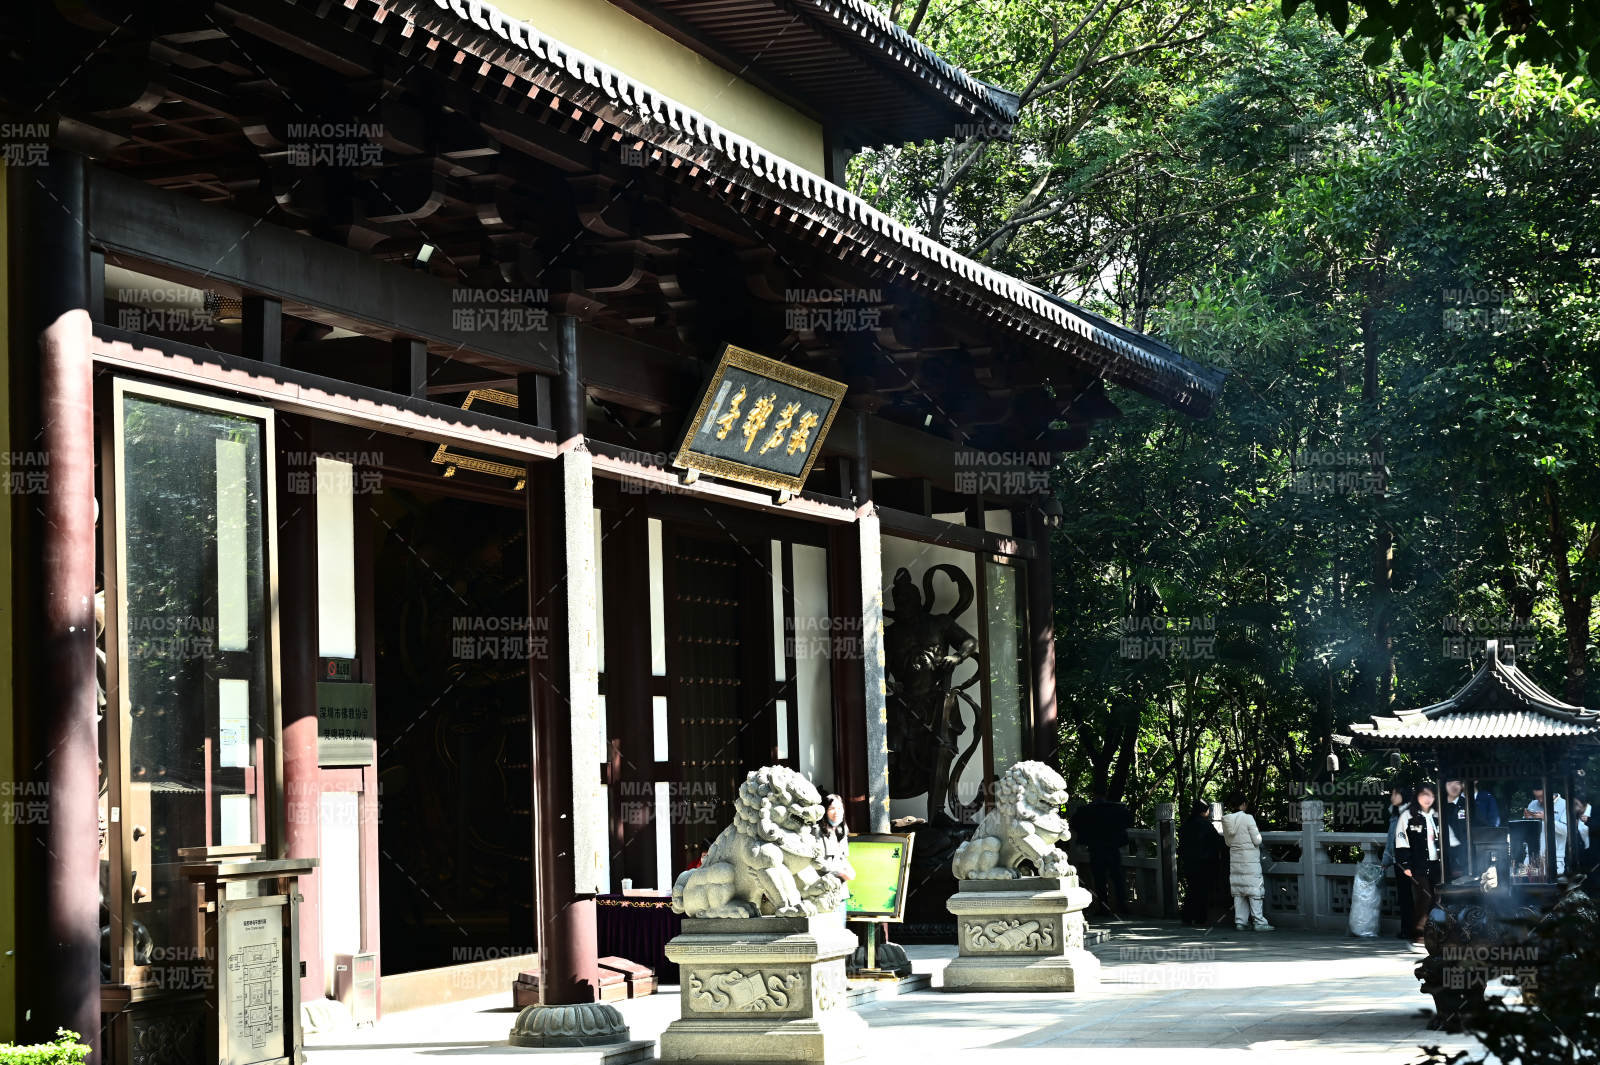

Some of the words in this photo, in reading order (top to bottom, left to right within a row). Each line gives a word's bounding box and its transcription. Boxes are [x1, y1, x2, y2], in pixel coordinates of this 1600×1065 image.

[319, 706, 368, 720] 深圳市佛教协会
